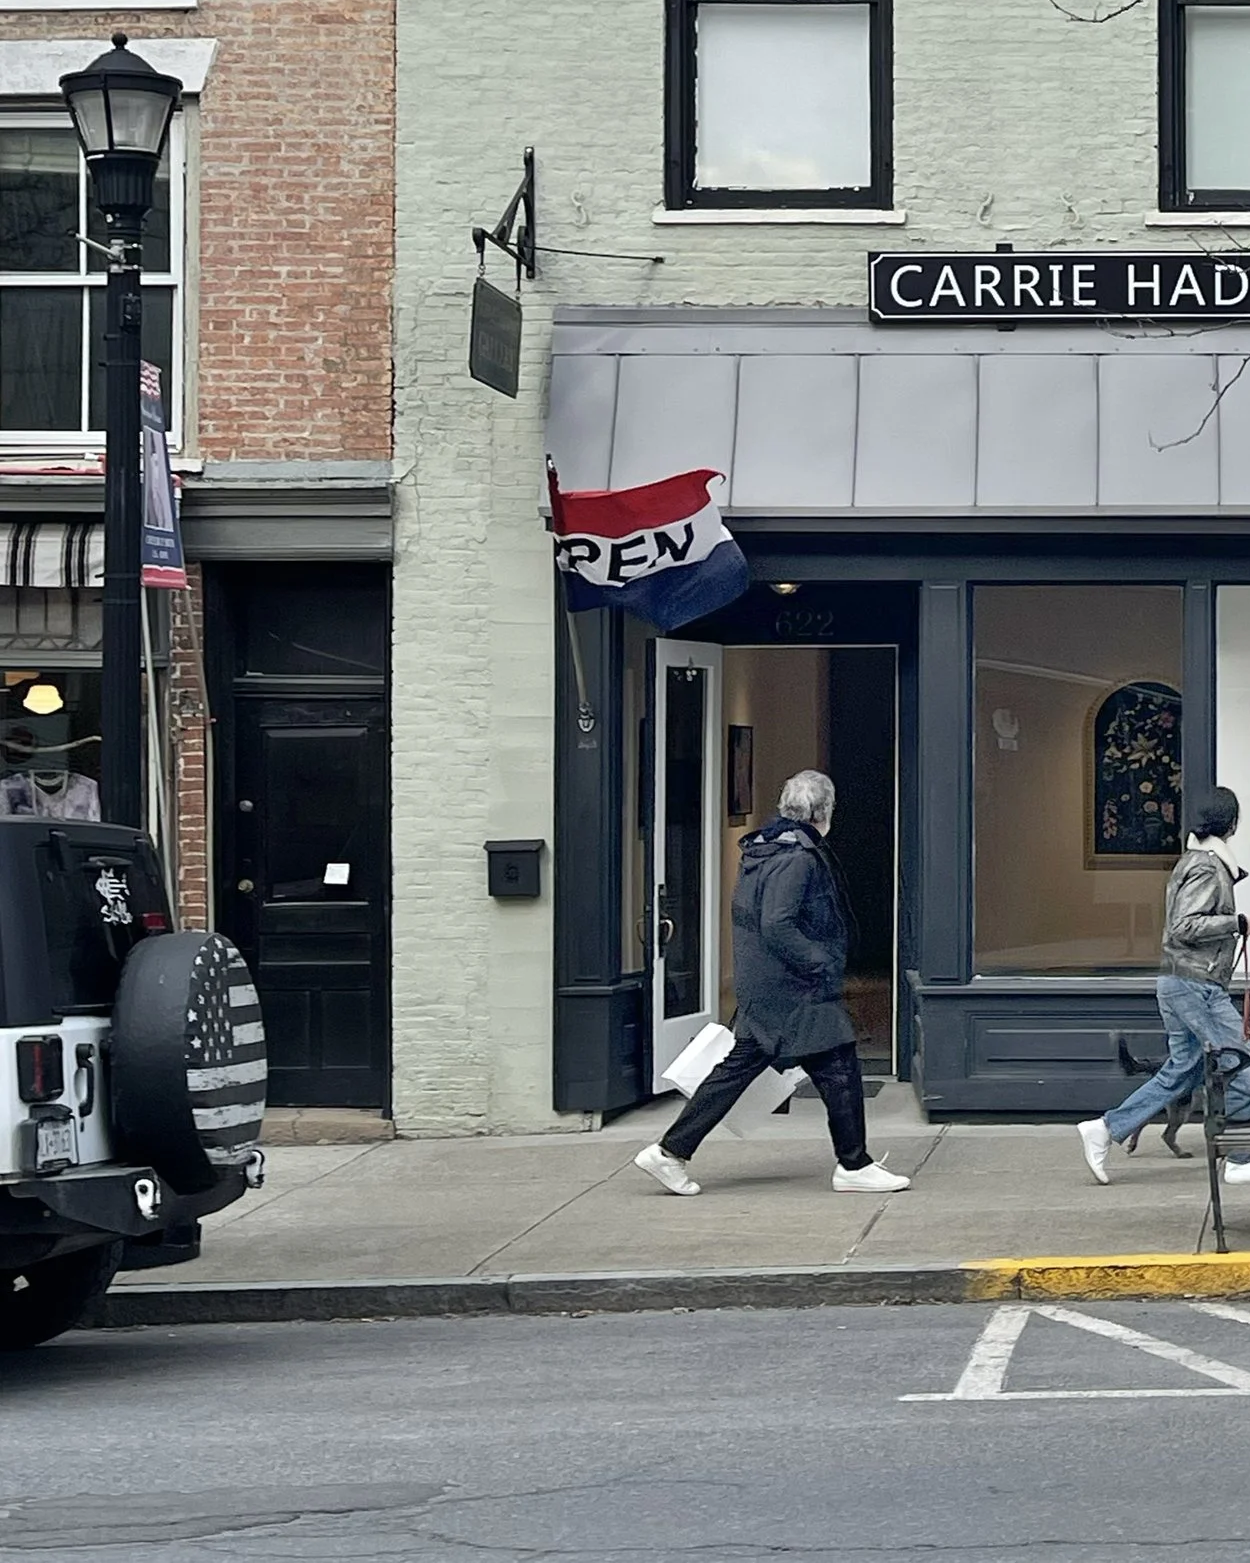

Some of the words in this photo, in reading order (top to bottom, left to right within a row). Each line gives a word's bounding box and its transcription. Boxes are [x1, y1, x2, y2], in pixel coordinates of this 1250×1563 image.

[890, 264, 1097, 307] CARRIE
[555, 522, 695, 583] PEN
[775, 610, 834, 636] 622
